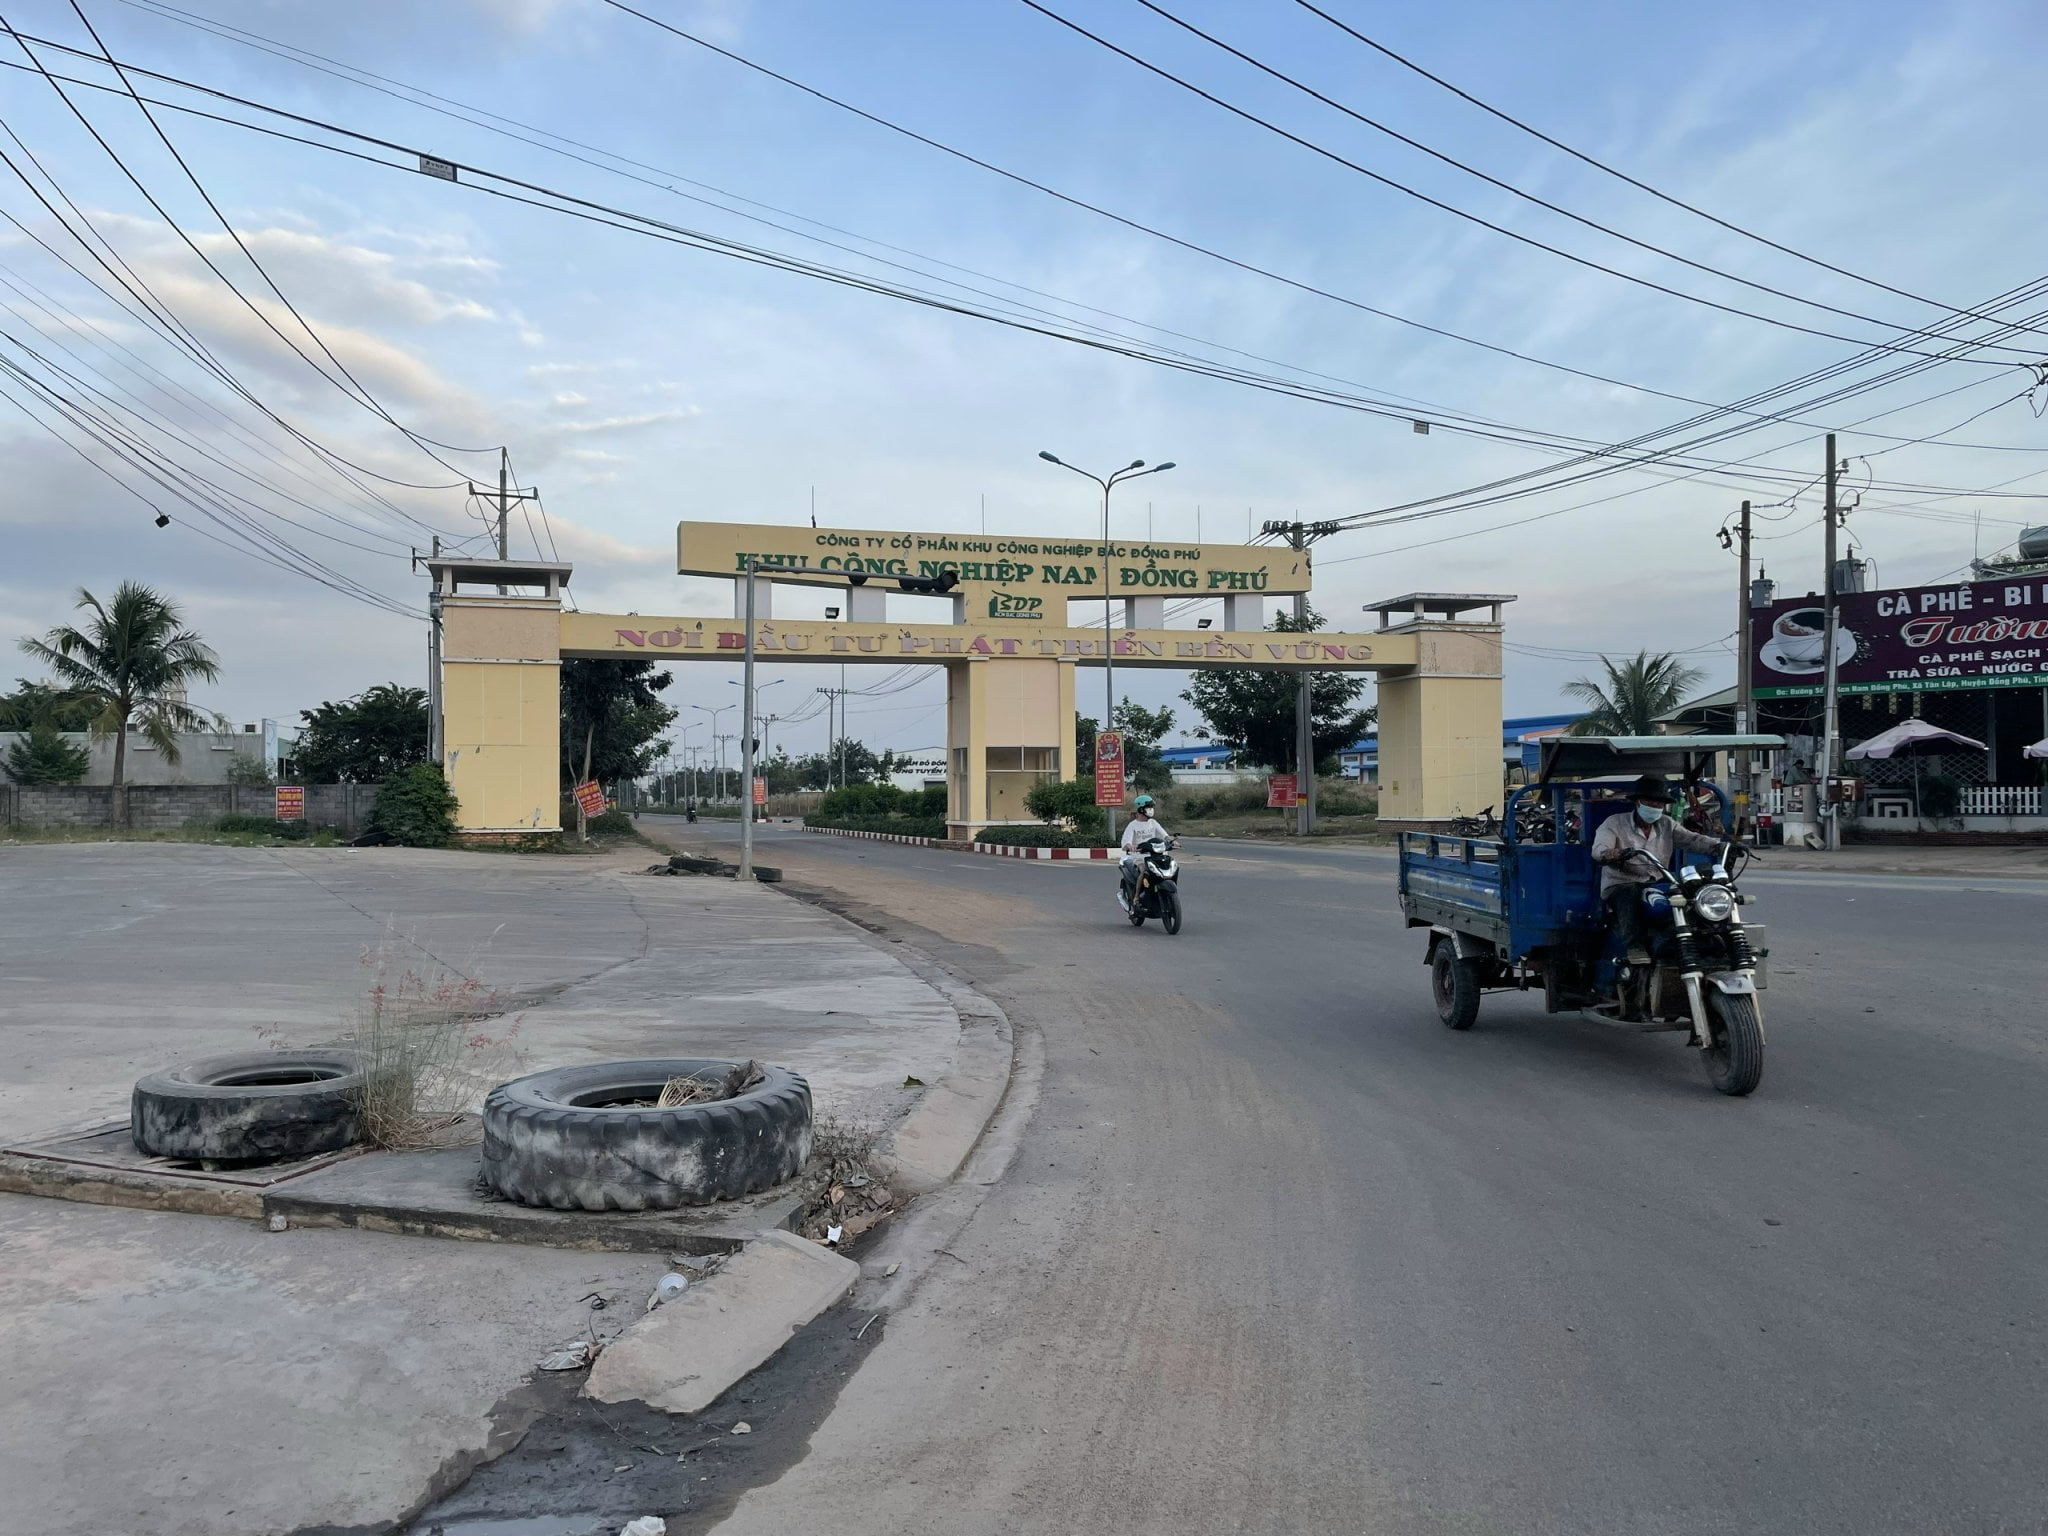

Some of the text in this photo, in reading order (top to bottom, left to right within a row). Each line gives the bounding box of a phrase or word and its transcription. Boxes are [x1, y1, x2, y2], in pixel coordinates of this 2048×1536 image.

[816, 533, 860, 547] CÔNG
[865, 537, 885, 548] TY
[890, 534, 913, 549] CỔ
[962, 541, 992, 553] KHU
[997, 541, 1039, 554] CÔNG
[1042, 544, 1093, 558] NGHIỆP
[1097, 543, 1126, 558] BẮC
[1174, 547, 1201, 561] PHÚ
[820, 552, 909, 576] CÔNG
[1120, 559, 1199, 588] ĐỒNG
[1208, 565, 1269, 590] PHÚ
[1877, 591, 1912, 617] CÀ
[1920, 586, 1973, 613] PHÊ
[2004, 585, 2031, 606] BI
[615, 626, 703, 649] NƠI
[825, 632, 888, 652] TƯ
[898, 632, 1023, 655] PHÁT
[1265, 640, 1374, 661] VỮNG
[1918, 648, 2041, 664] CÀ PHÊ SẠCH
[1887, 667, 1921, 679] TRÀ
[1926, 665, 1962, 677] SỮA
[1982, 662, 2033, 674] NƯỚC
[1961, 679, 1987, 688] Huyện
